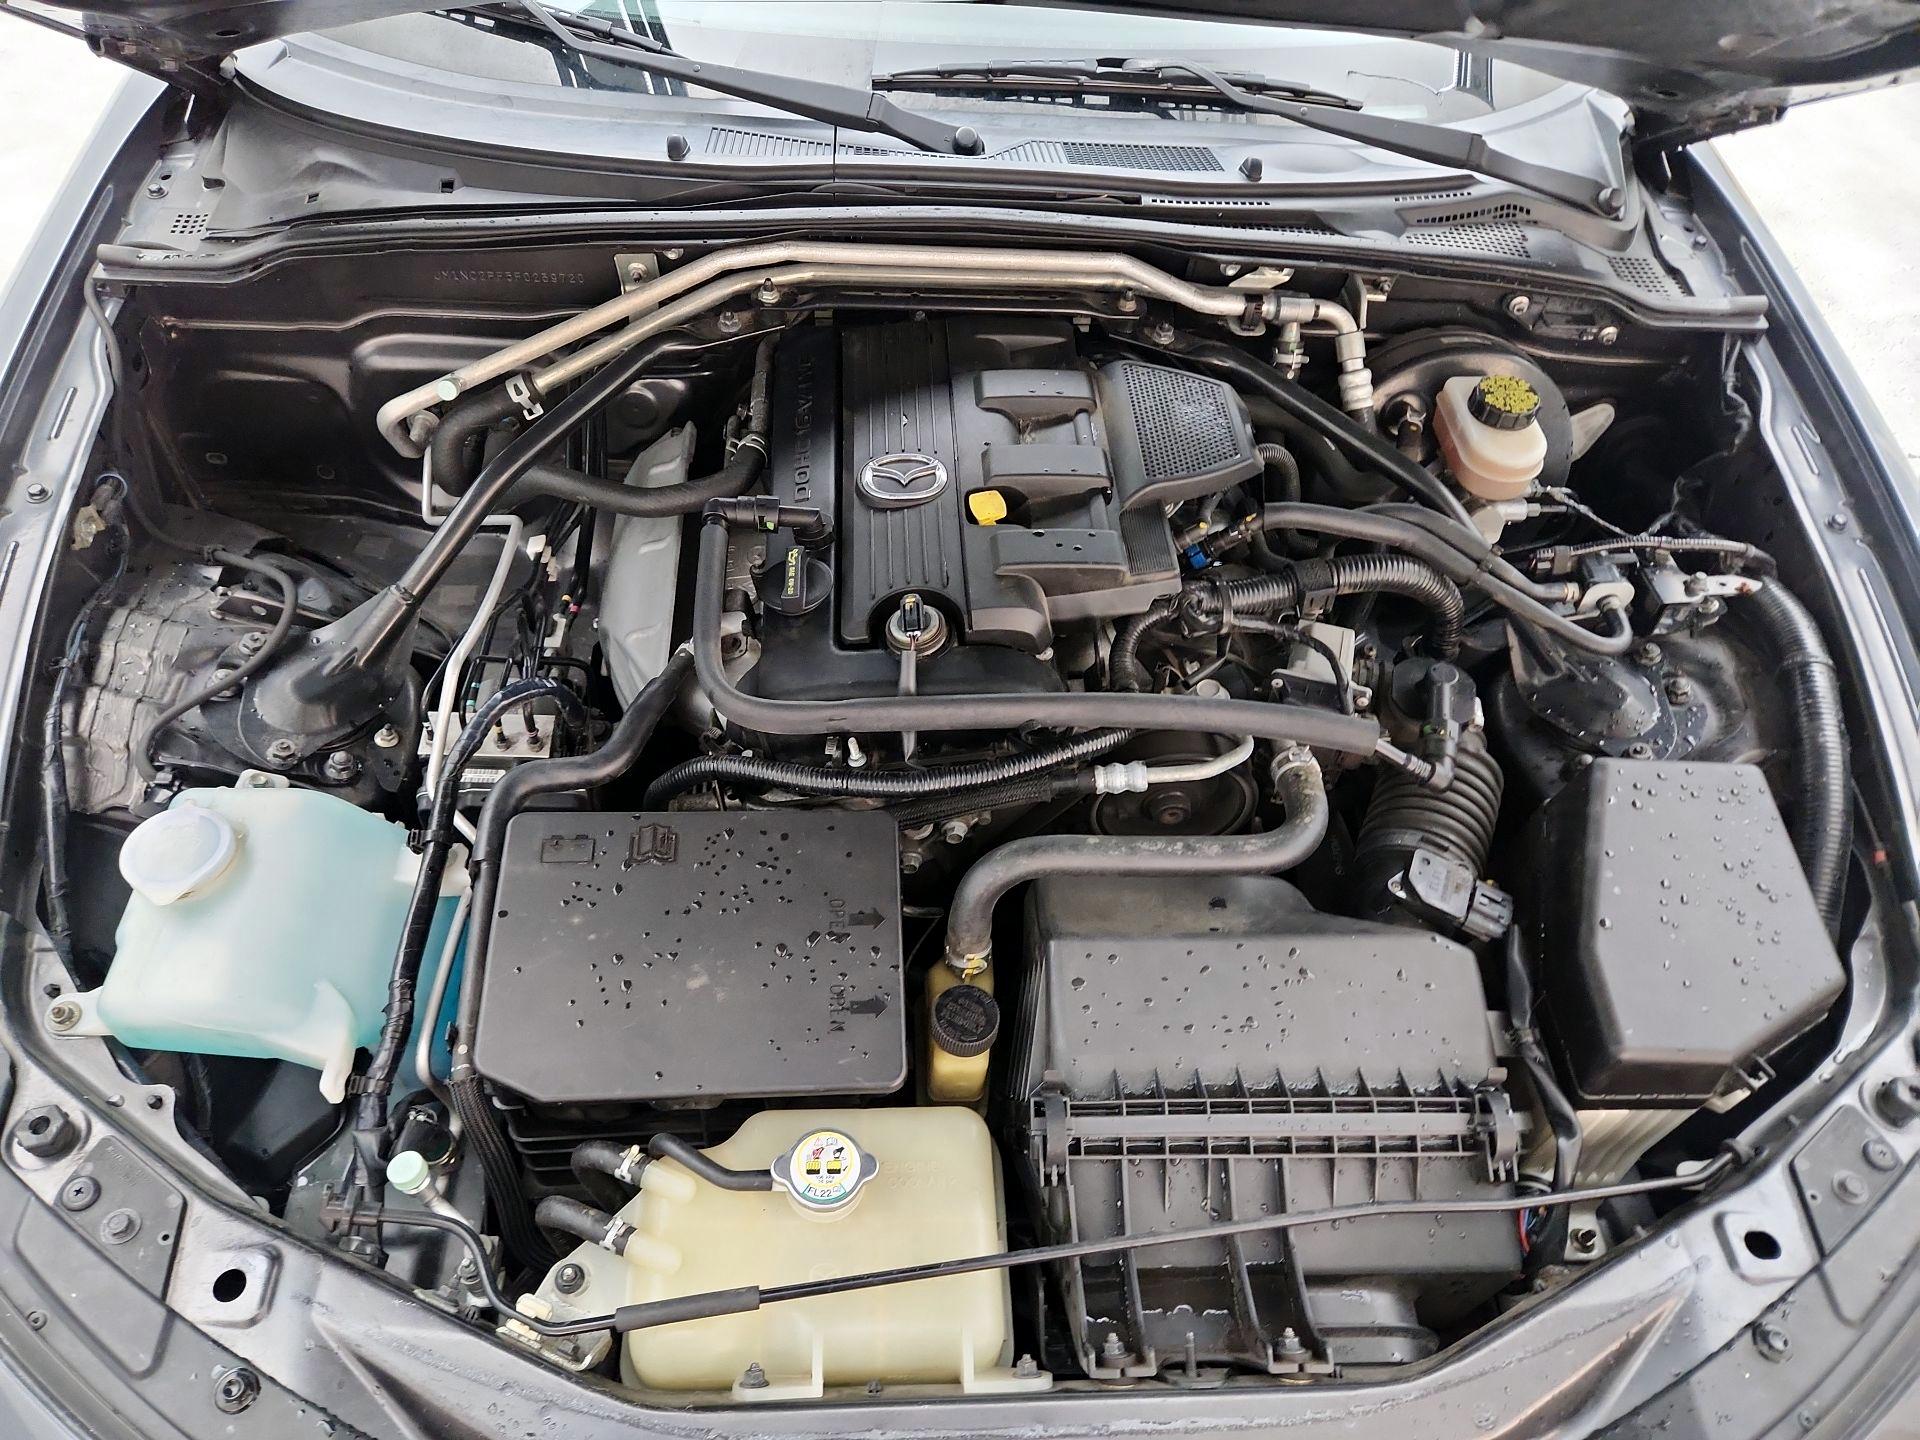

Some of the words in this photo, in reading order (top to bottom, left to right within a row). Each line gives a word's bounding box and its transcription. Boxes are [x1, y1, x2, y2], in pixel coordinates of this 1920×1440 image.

[794, 439, 811, 503] DOHC
[829, 984, 846, 1034] OPEN
[807, 1186, 833, 1198] FL22
